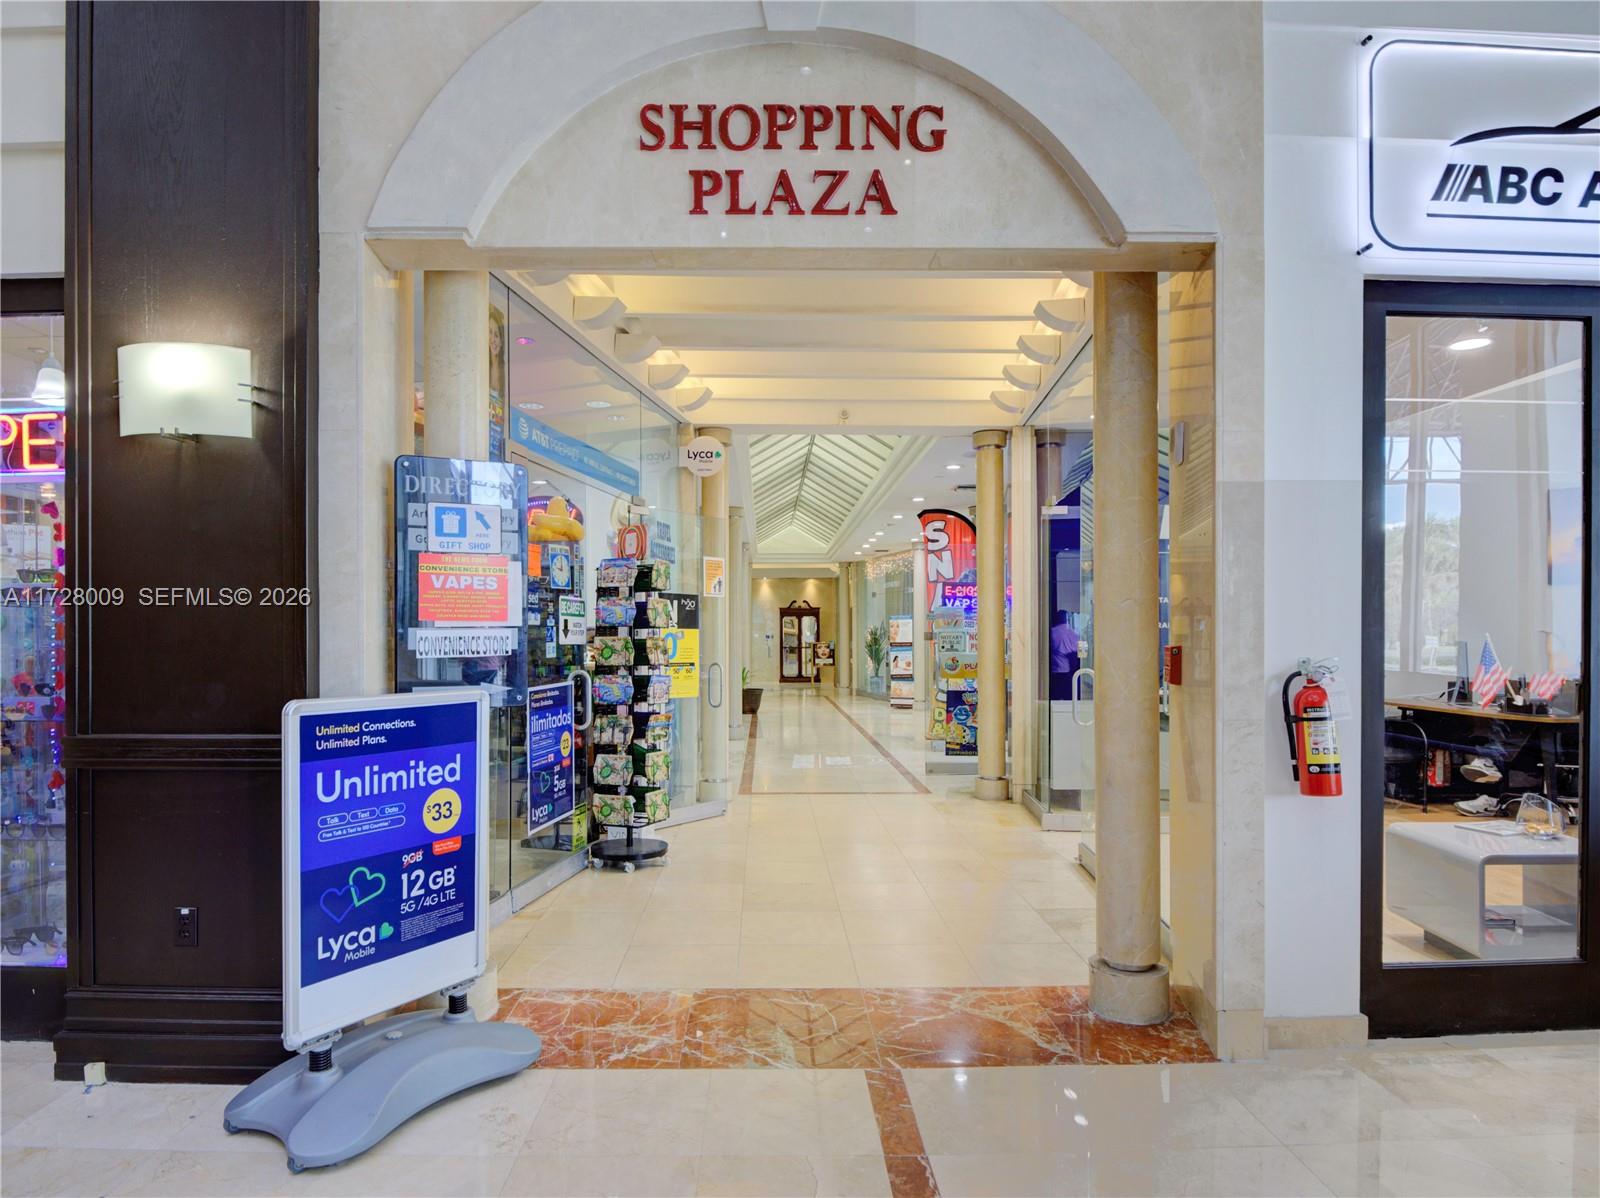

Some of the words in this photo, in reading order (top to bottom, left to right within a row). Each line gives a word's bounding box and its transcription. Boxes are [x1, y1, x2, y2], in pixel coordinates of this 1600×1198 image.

[639, 104, 947, 152] SHOPPING
[689, 169, 898, 215] PLAZA
[1454, 164, 1565, 206] ABC
[687, 449, 713, 461] Lyca
[439, 541, 463, 550] GIFT
[468, 542, 491, 551] SHOP
[419, 564, 480, 573] CONVENIENCE
[431, 574, 498, 590] VAPES
[417, 635, 480, 656] CONVENIENCE
[482, 636, 510, 655] STORE
[315, 723, 360, 737] Unlimited
[362, 719, 417, 732] Connections.
[530, 710, 571, 733] ilimitados
[315, 737, 360, 750] Unlimited
[362, 735, 388, 745] Plans.
[316, 753, 461, 803] Unlimited
[357, 811, 370, 819] Text
[385, 806, 399, 814] Data
[426, 801, 453, 822] $33
[532, 804, 549, 821] Lyca
[326, 816, 339, 825] Talk
[401, 869, 426, 900] 12
[400, 900, 416, 914] 5G
[440, 888, 456, 903] LTE
[317, 925, 376, 960] Lyca
[344, 947, 376, 963] Mobile
